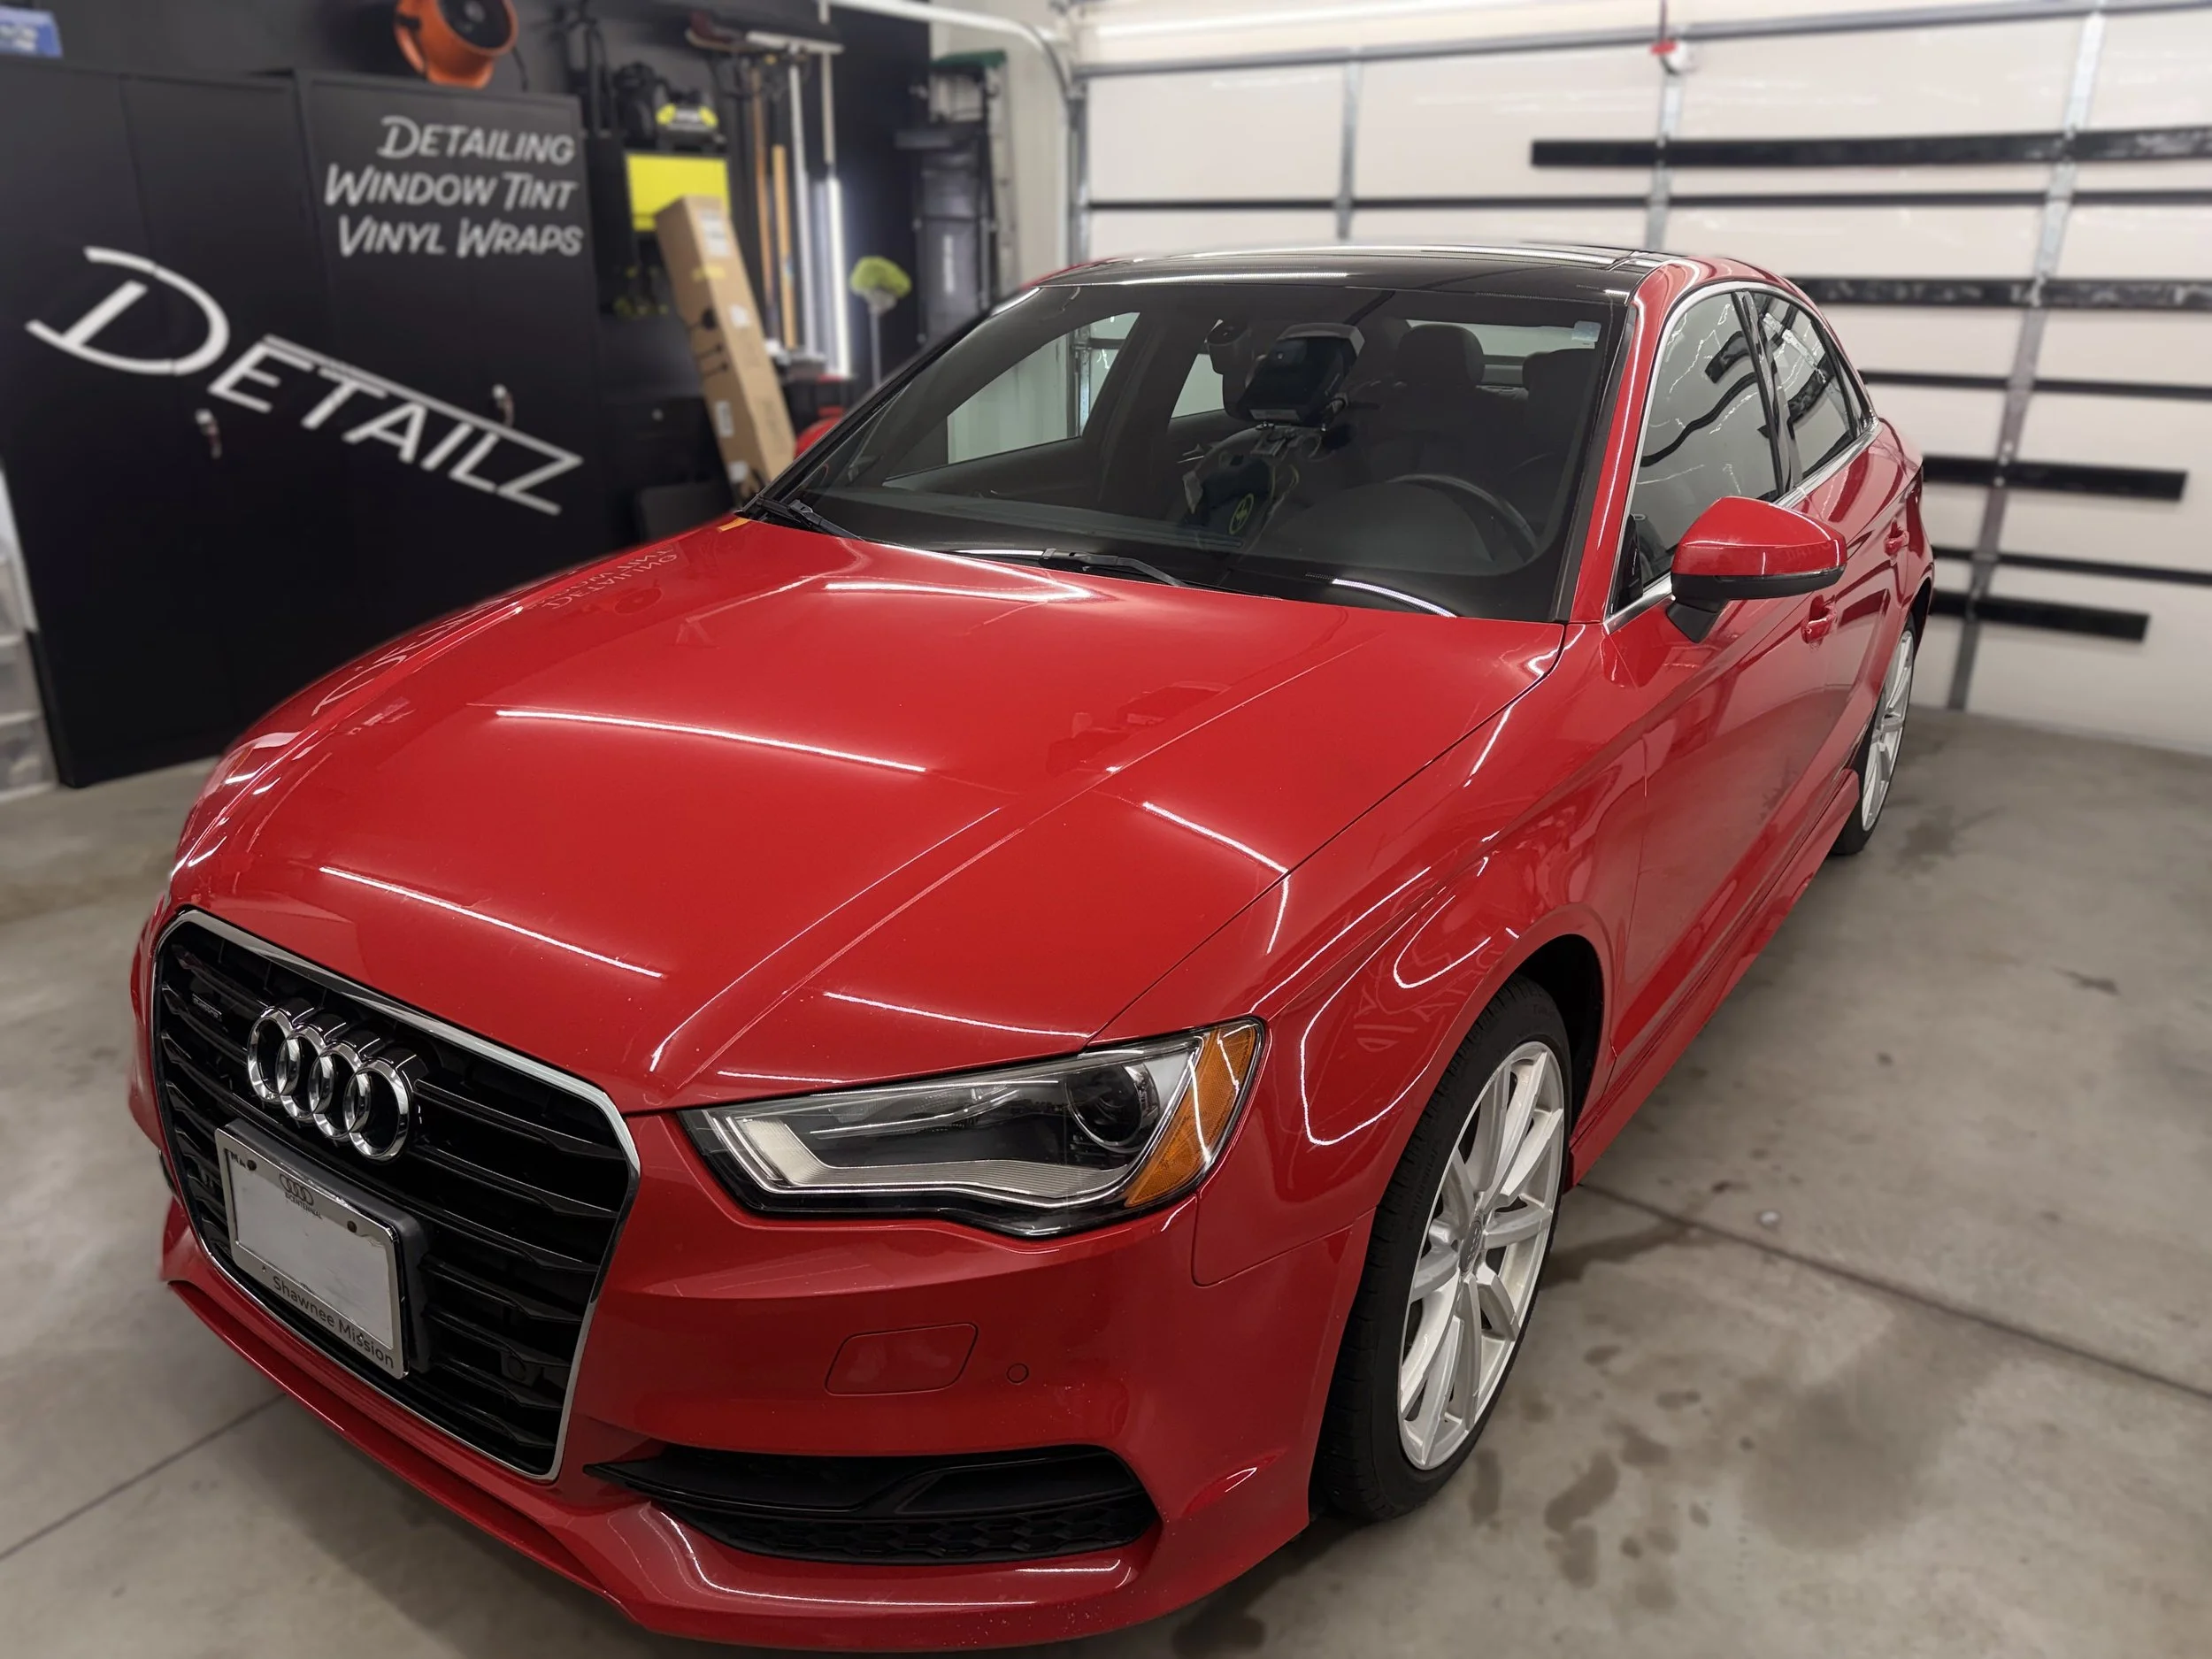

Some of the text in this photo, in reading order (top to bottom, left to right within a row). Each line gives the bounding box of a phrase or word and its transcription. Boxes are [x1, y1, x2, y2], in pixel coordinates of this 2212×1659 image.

[377, 115, 575, 165] DETAILING
[324, 163, 579, 211] WINDOW TINT
[339, 215, 584, 257] VINYL WRAPS
[26, 247, 583, 515] DETAILZ
[273, 1275, 395, 1369] Shawnee Mission
